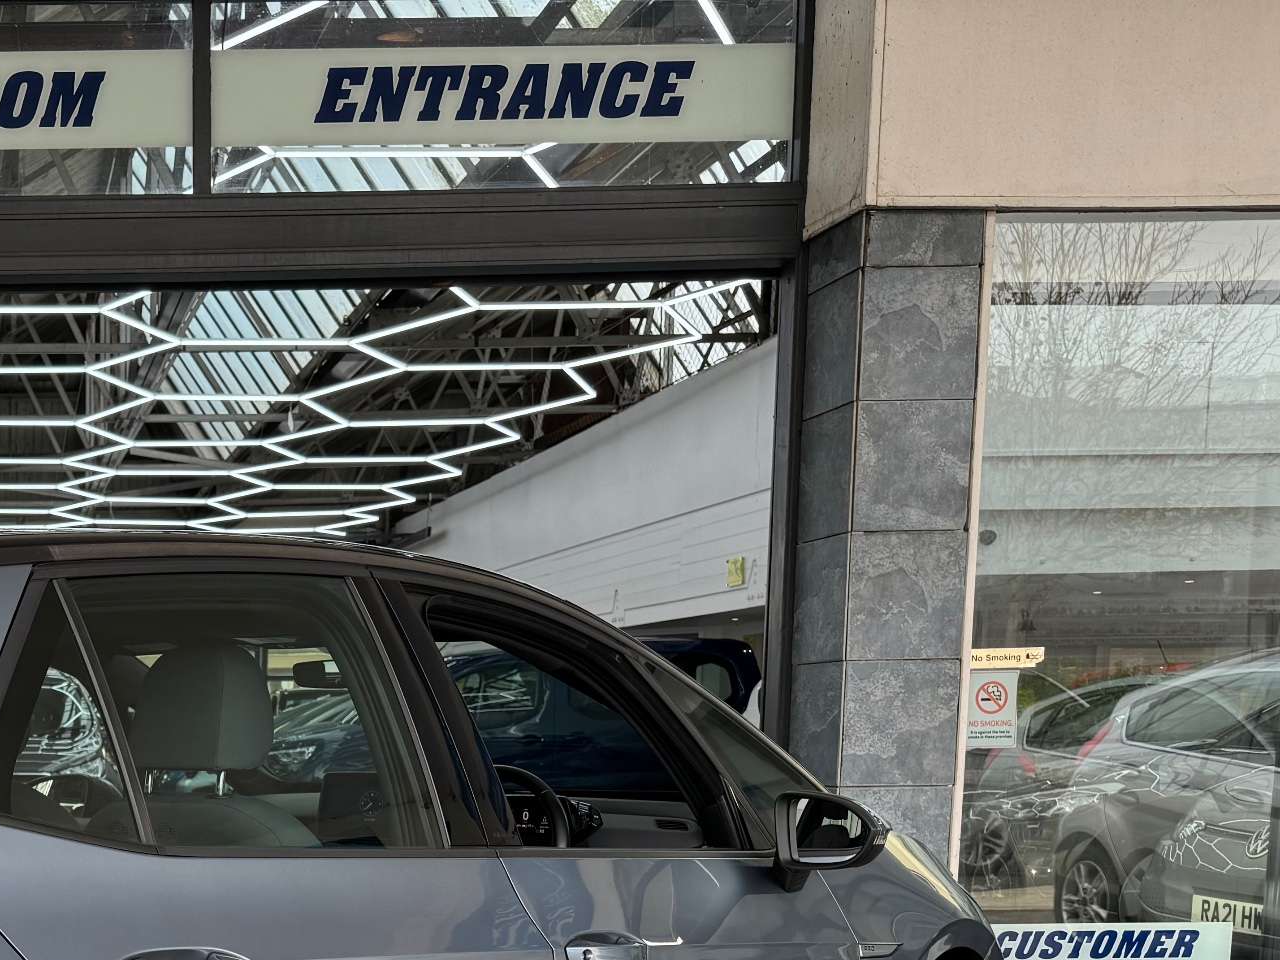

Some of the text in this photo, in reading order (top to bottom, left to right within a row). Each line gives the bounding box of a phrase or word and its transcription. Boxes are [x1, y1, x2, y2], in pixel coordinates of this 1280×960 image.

[313, 60, 696, 124] ENTRANCE
[985, 653, 1021, 662] Smoking
[996, 929, 1200, 960] CUSTOMER
